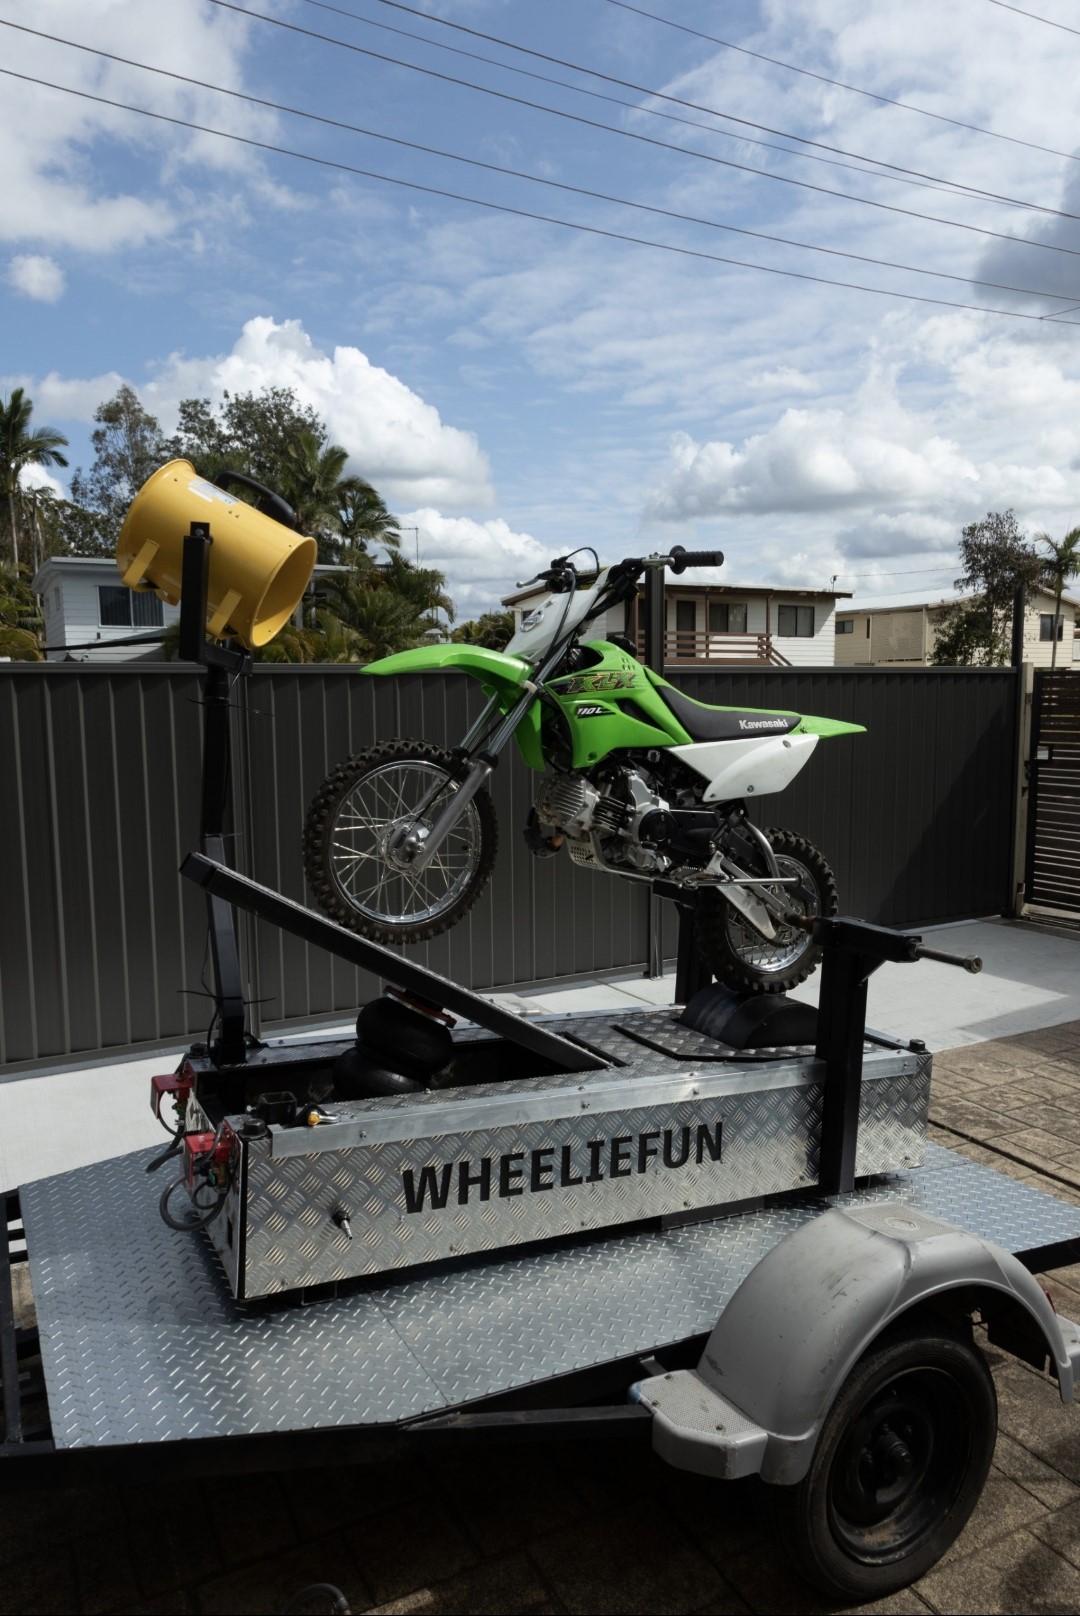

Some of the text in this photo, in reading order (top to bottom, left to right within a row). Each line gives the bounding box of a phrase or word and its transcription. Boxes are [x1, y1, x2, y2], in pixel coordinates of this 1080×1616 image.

[566, 671, 636, 694] KLX
[738, 718, 789, 730] Kawasaki
[402, 1121, 724, 1214] WHEELIEFUN
